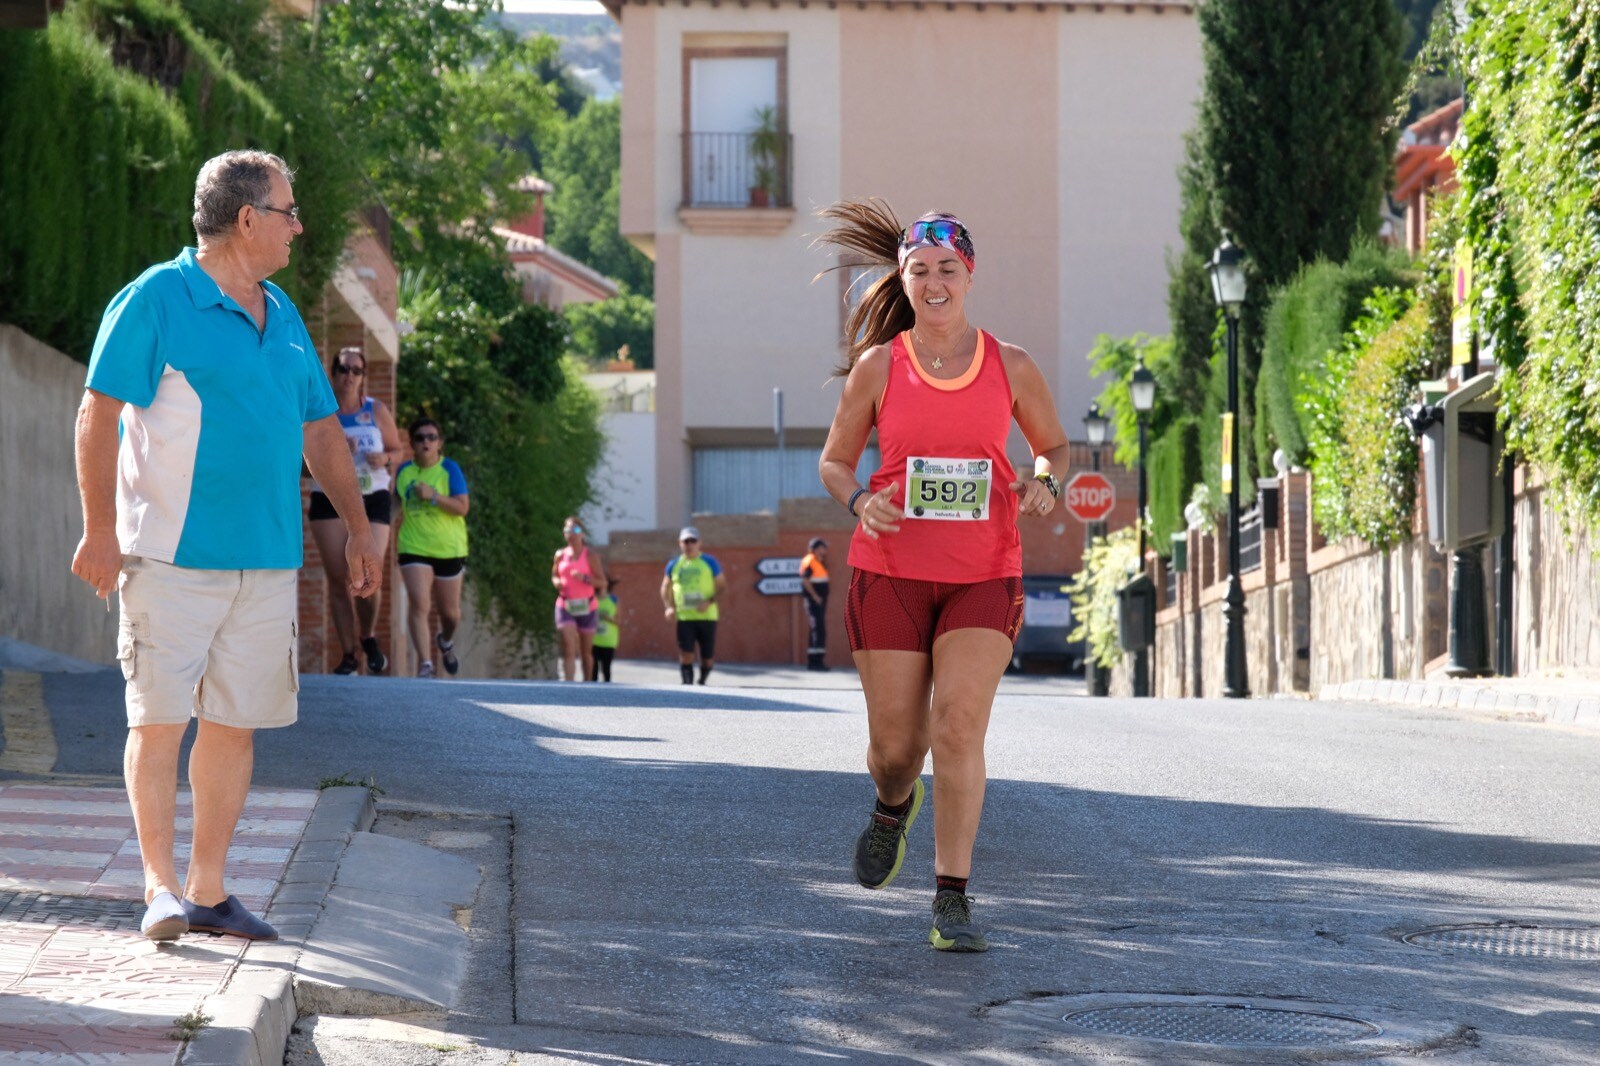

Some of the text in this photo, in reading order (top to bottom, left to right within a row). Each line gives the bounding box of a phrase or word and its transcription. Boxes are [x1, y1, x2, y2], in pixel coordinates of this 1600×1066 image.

[921, 480, 977, 503] 592
[1069, 487, 1111, 507] STOP
[765, 561, 799, 571] LA ZU
[765, 582, 800, 590] BELLAV
